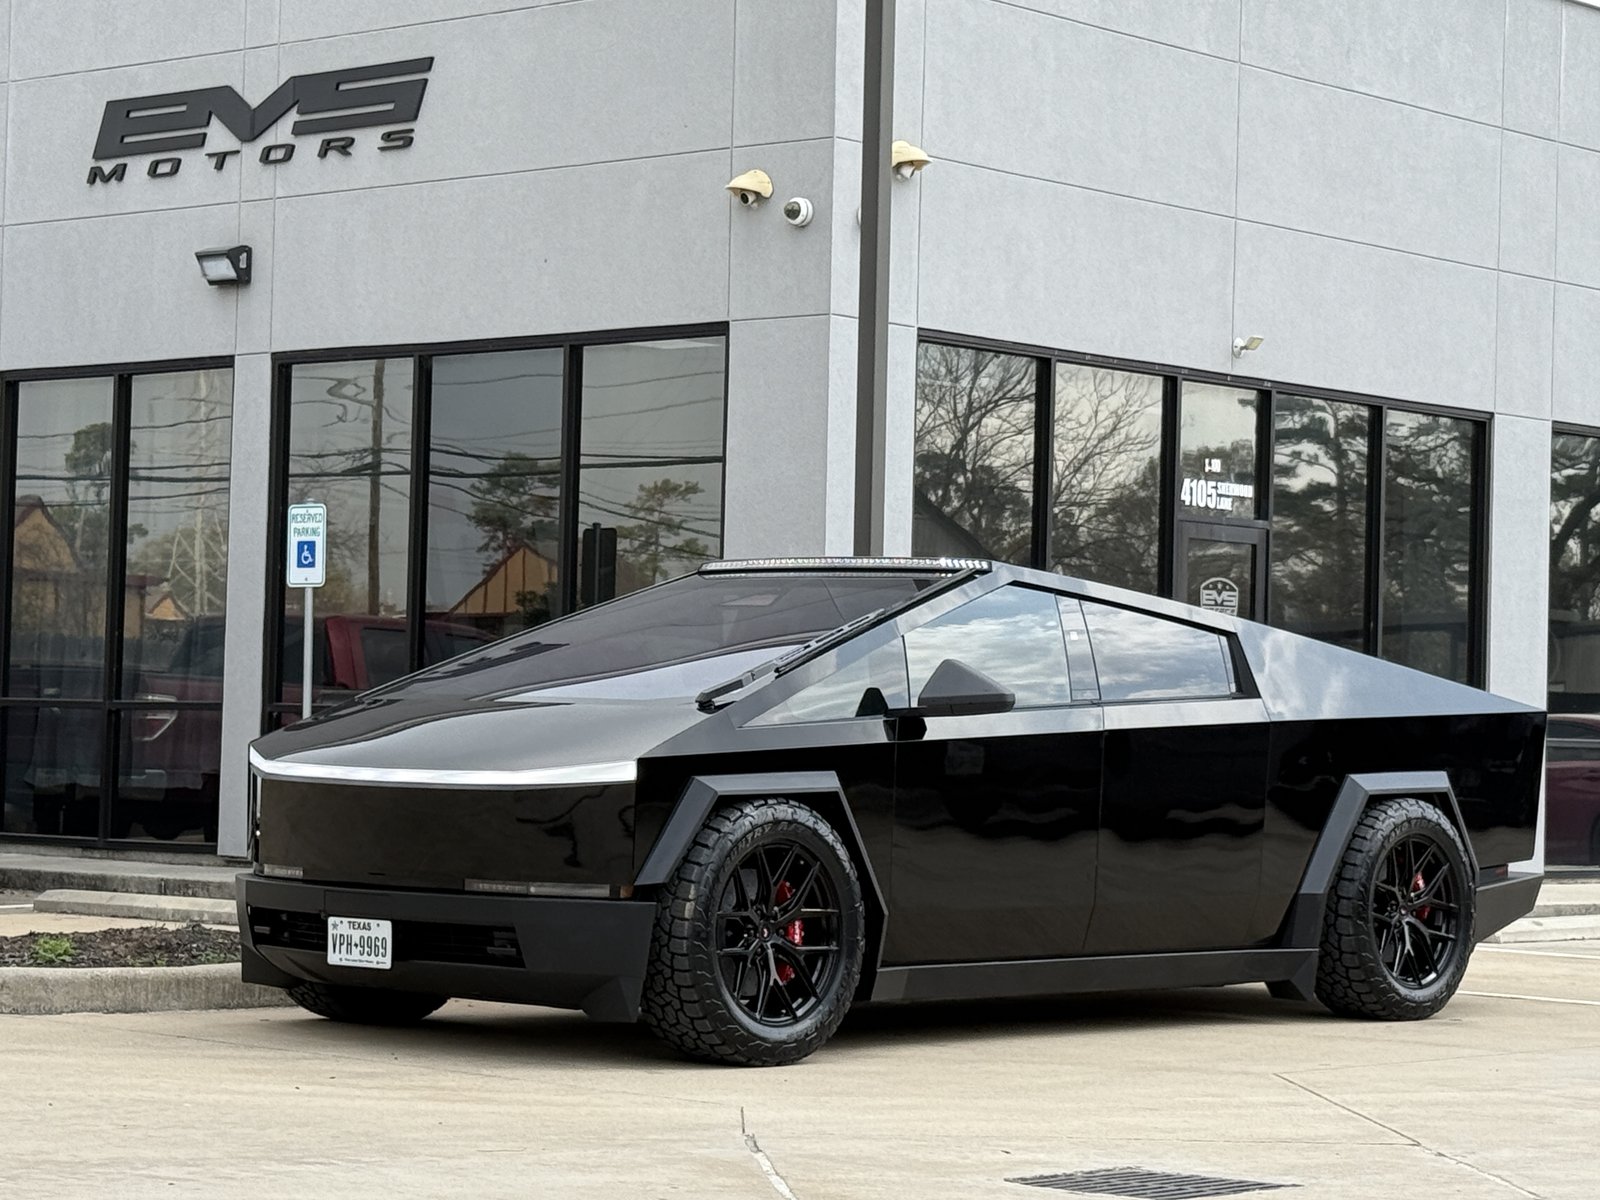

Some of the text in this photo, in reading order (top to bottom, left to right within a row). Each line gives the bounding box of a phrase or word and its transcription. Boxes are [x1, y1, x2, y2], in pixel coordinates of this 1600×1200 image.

[86, 128, 416, 186] MOTORS
[1181, 478, 1217, 509] 4105
[292, 513, 322, 523] RESERVED
[294, 527, 320, 537] PARKING
[347, 920, 372, 931] TEXAS
